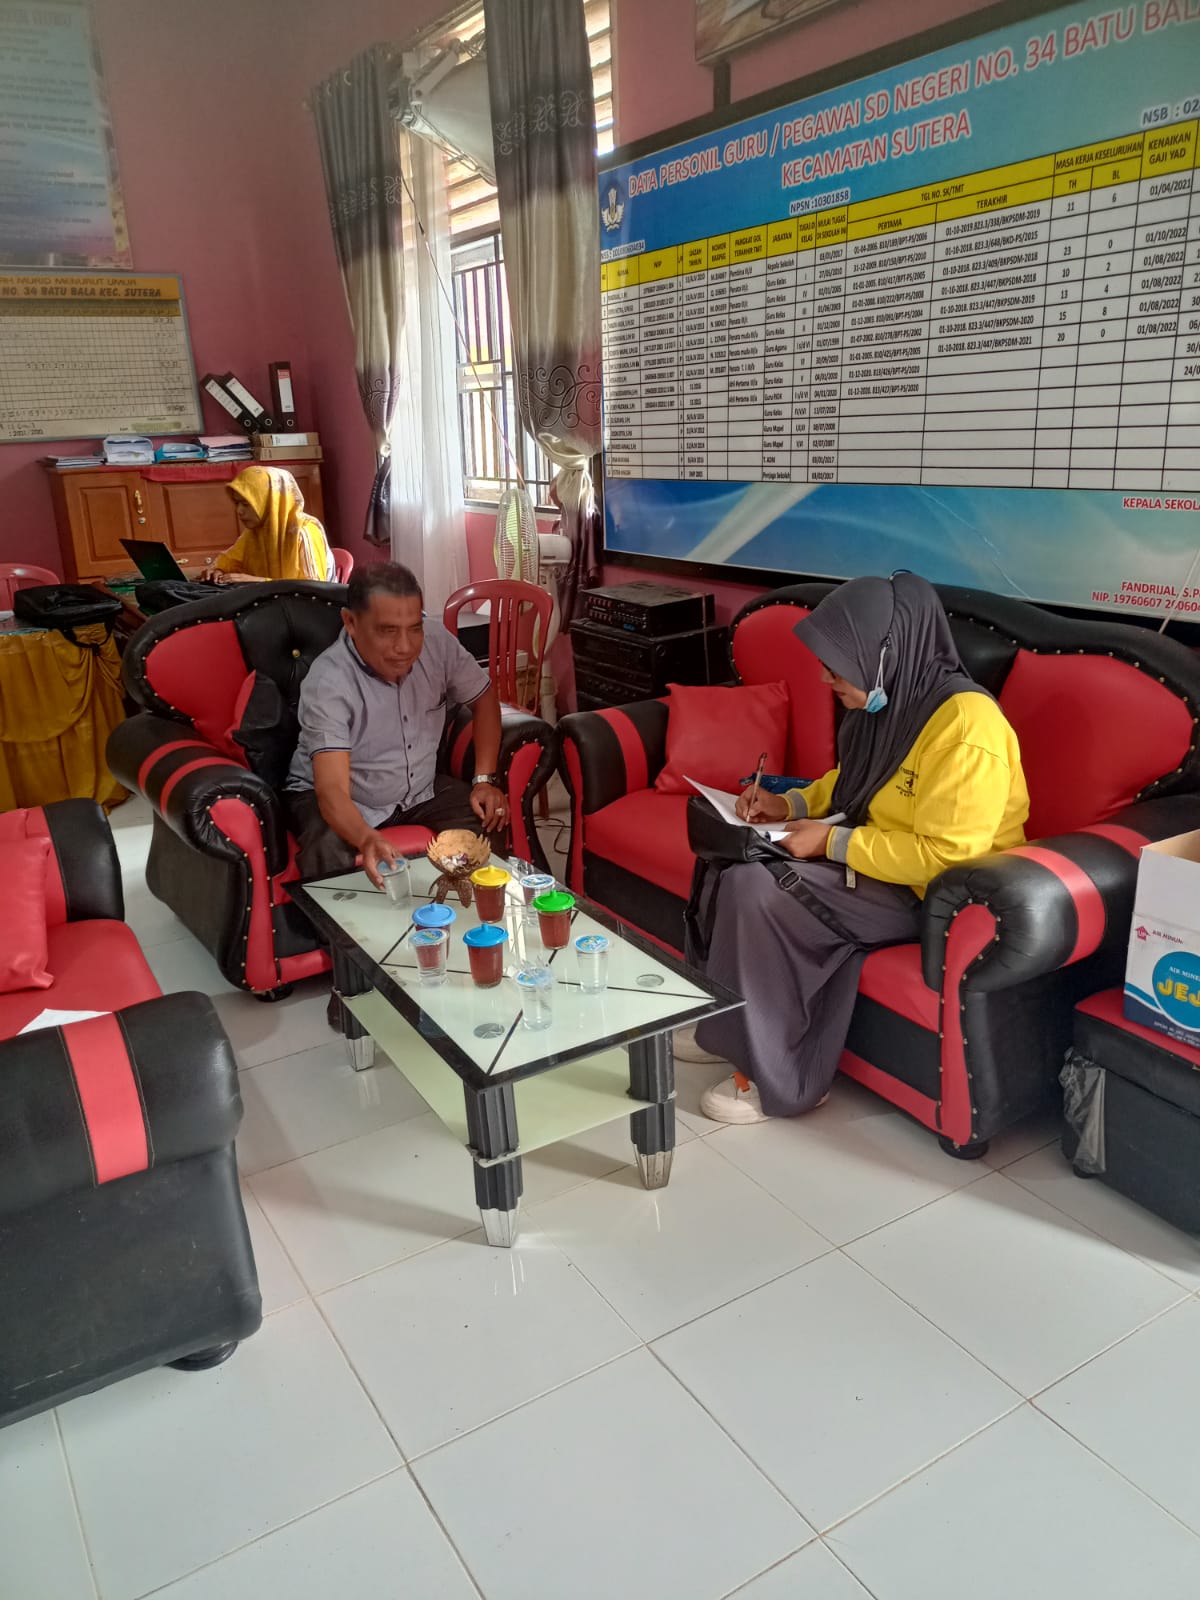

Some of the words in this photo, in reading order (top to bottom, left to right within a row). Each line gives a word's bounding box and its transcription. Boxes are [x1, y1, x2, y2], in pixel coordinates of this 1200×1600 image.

[629, 168, 658, 198] DATA
[660, 149, 721, 187] PERSONIL
[723, 131, 769, 167] GURU
[768, 122, 780, 157] /
[782, 98, 861, 149] PEGAWAI
[863, 90, 890, 124] SD
[894, 60, 971, 114] NEGERI
[975, 46, 1018, 88] NO.
[1024, 31, 1057, 71] 34
[1063, 5, 1135, 58] BATU
[1143, 0, 1200, 33] BAL
[1142, 106, 1168, 125] NSB
[1182, 98, 1200, 115] 02
[782, 133, 887, 189] KECAMATAN
[891, 109, 972, 159] SUTERA
[1148, 131, 1191, 150] KENAIKAN
[1055, 158, 1074, 170] MASA
[1075, 154, 1094, 166] KERJA
[1095, 141, 1144, 162] KESELURUHAN
[1149, 153, 1168, 165] GAJI
[1170, 148, 1186, 161] YAD
[943, 183, 964, 199] SK/TMT
[1066, 202, 1075, 212] 11
[1149, 178, 1191, 196] 01/04/2021
[790, 200, 810, 214] NPSN
[976, 195, 1008, 209] TERAKHIR
[877, 218, 902, 232] PERTAMA
[1063, 246, 1072, 256] 23
[1145, 227, 1187, 243] 01/10/2022
[1062, 268, 1070, 278] 10
[1143, 251, 1184, 266] 01/08/2022
[41, 287, 67, 296] BATU
[71, 287, 96, 296] BALA
[99, 288, 121, 297] KEC.
[124, 288, 161, 297] SUTERA
[1060, 289, 1068, 299] 13
[1141, 275, 1182, 289] 01/08/2022
[1059, 311, 1067, 321] 15
[1139, 298, 1179, 312] 01/08/2022
[1057, 332, 1065, 342] 20
[1137, 322, 1177, 334] 01/08/2022
[1123, 497, 1161, 509] KEPALA
[1164, 499, 1200, 511] SEKOL
[1092, 592, 1111, 602] NIP.
[1113, 593, 1162, 608] 19760607
[1182, 588, 1200, 599] S.P
